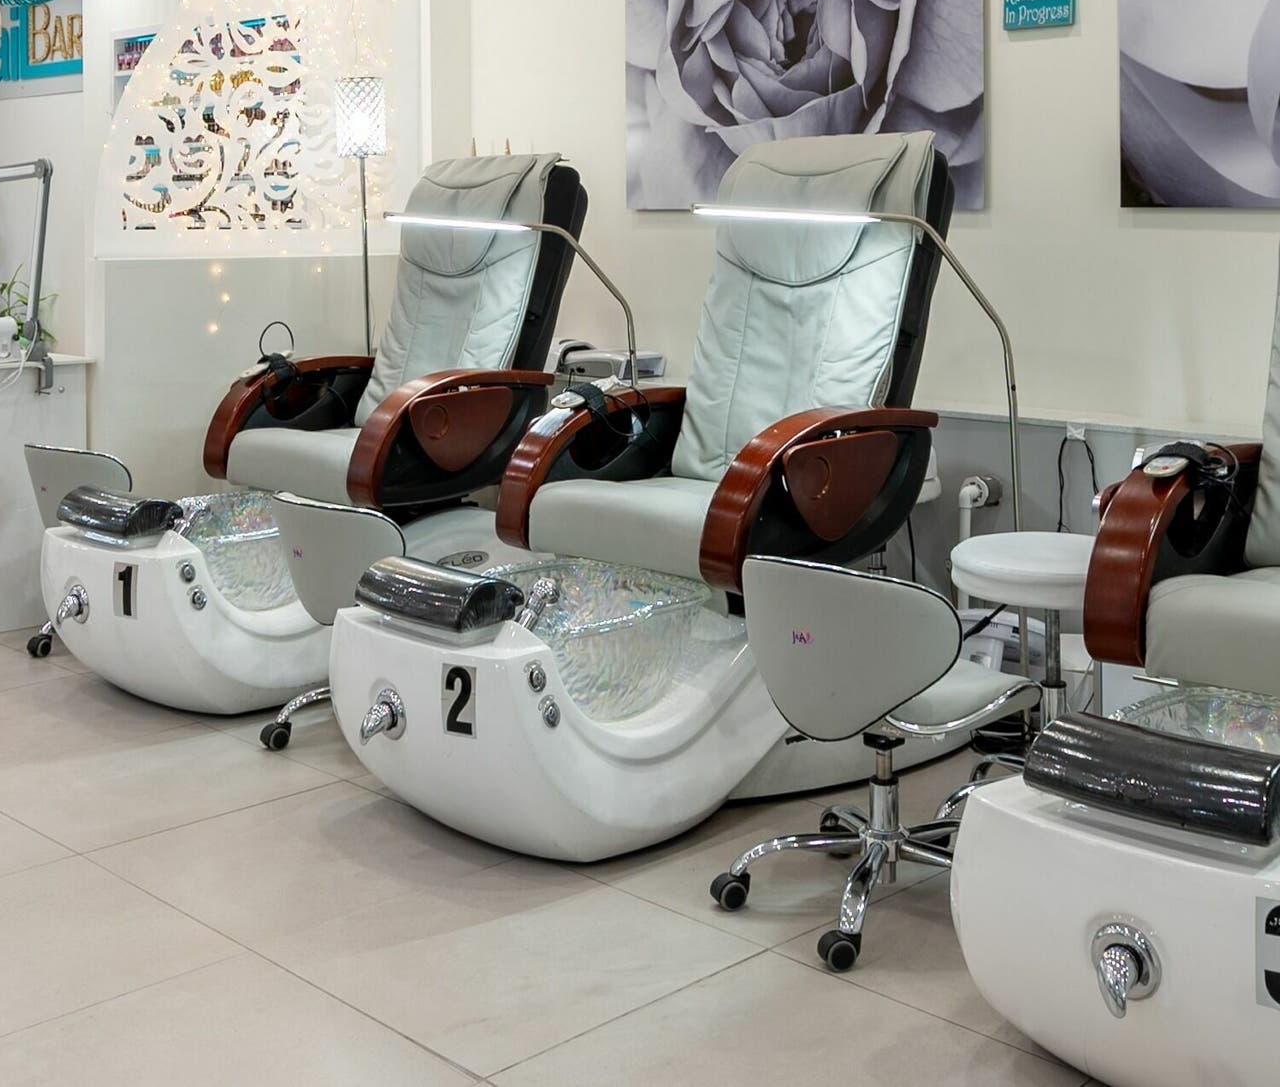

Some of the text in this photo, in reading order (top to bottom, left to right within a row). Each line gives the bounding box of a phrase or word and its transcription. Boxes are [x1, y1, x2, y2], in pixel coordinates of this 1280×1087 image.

[1005, 5, 1070, 25] In Progress
[118, 565, 133, 616] 1
[445, 665, 473, 736] 2
